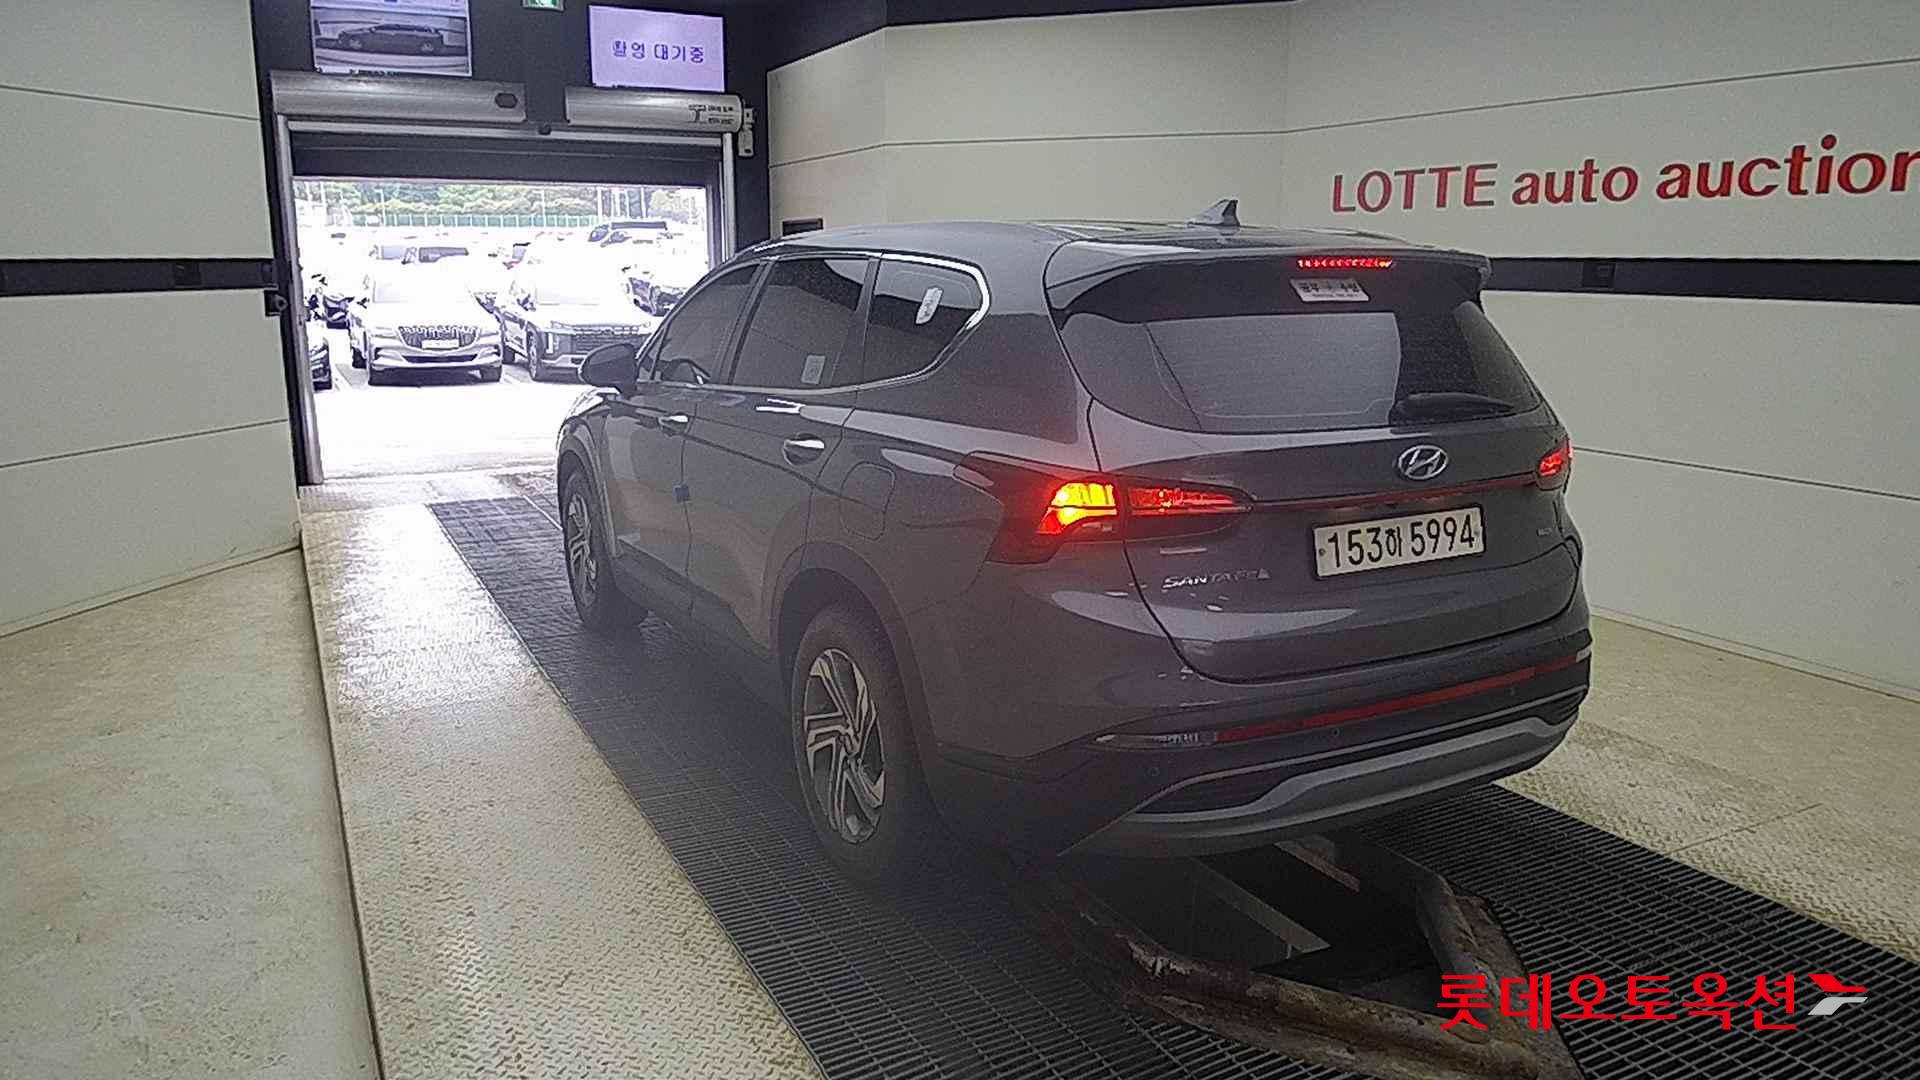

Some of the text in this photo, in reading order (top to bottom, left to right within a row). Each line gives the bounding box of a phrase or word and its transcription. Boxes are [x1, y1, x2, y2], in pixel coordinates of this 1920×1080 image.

[653, 43, 705, 64] 대기중
[1332, 163, 1497, 212] LOTTE
[1512, 158, 1639, 205] auto
[1409, 513, 1475, 558] 5994
